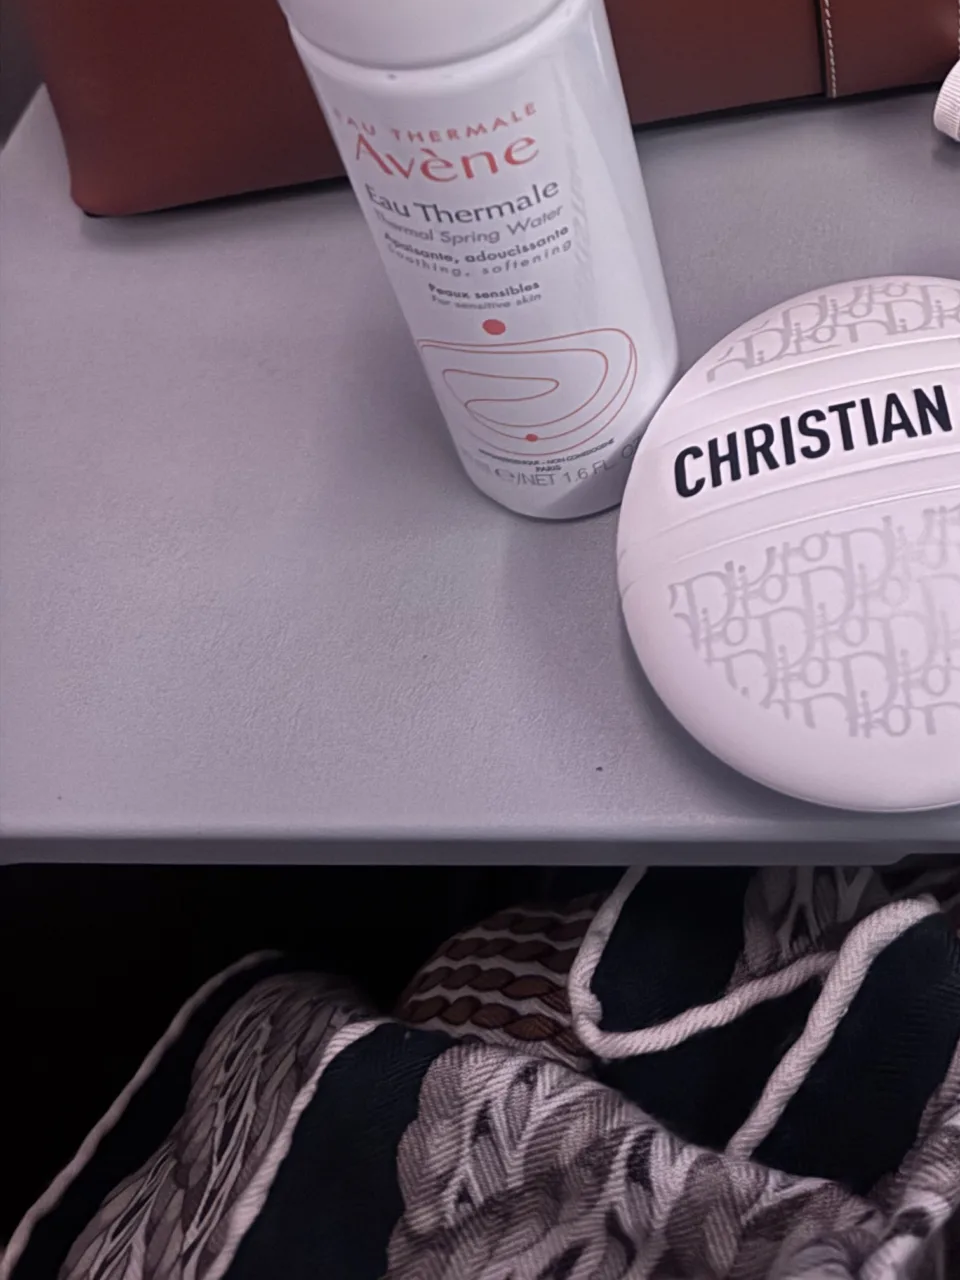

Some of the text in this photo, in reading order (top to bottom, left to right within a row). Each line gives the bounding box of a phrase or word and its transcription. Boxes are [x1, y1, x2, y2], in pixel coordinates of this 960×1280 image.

[391, 102, 537, 142] THERMALE
[355, 133, 540, 183] Avène
[364, 181, 559, 223] Eau Thermale
[440, 231, 500, 246] Spring
[507, 205, 563, 235] Water
[465, 226, 568, 262] adoucissante
[482, 239, 572, 275] softening
[475, 282, 540, 300] sensibles
[516, 293, 542, 307] skin
[674, 384, 953, 498] CHRISTIAN
